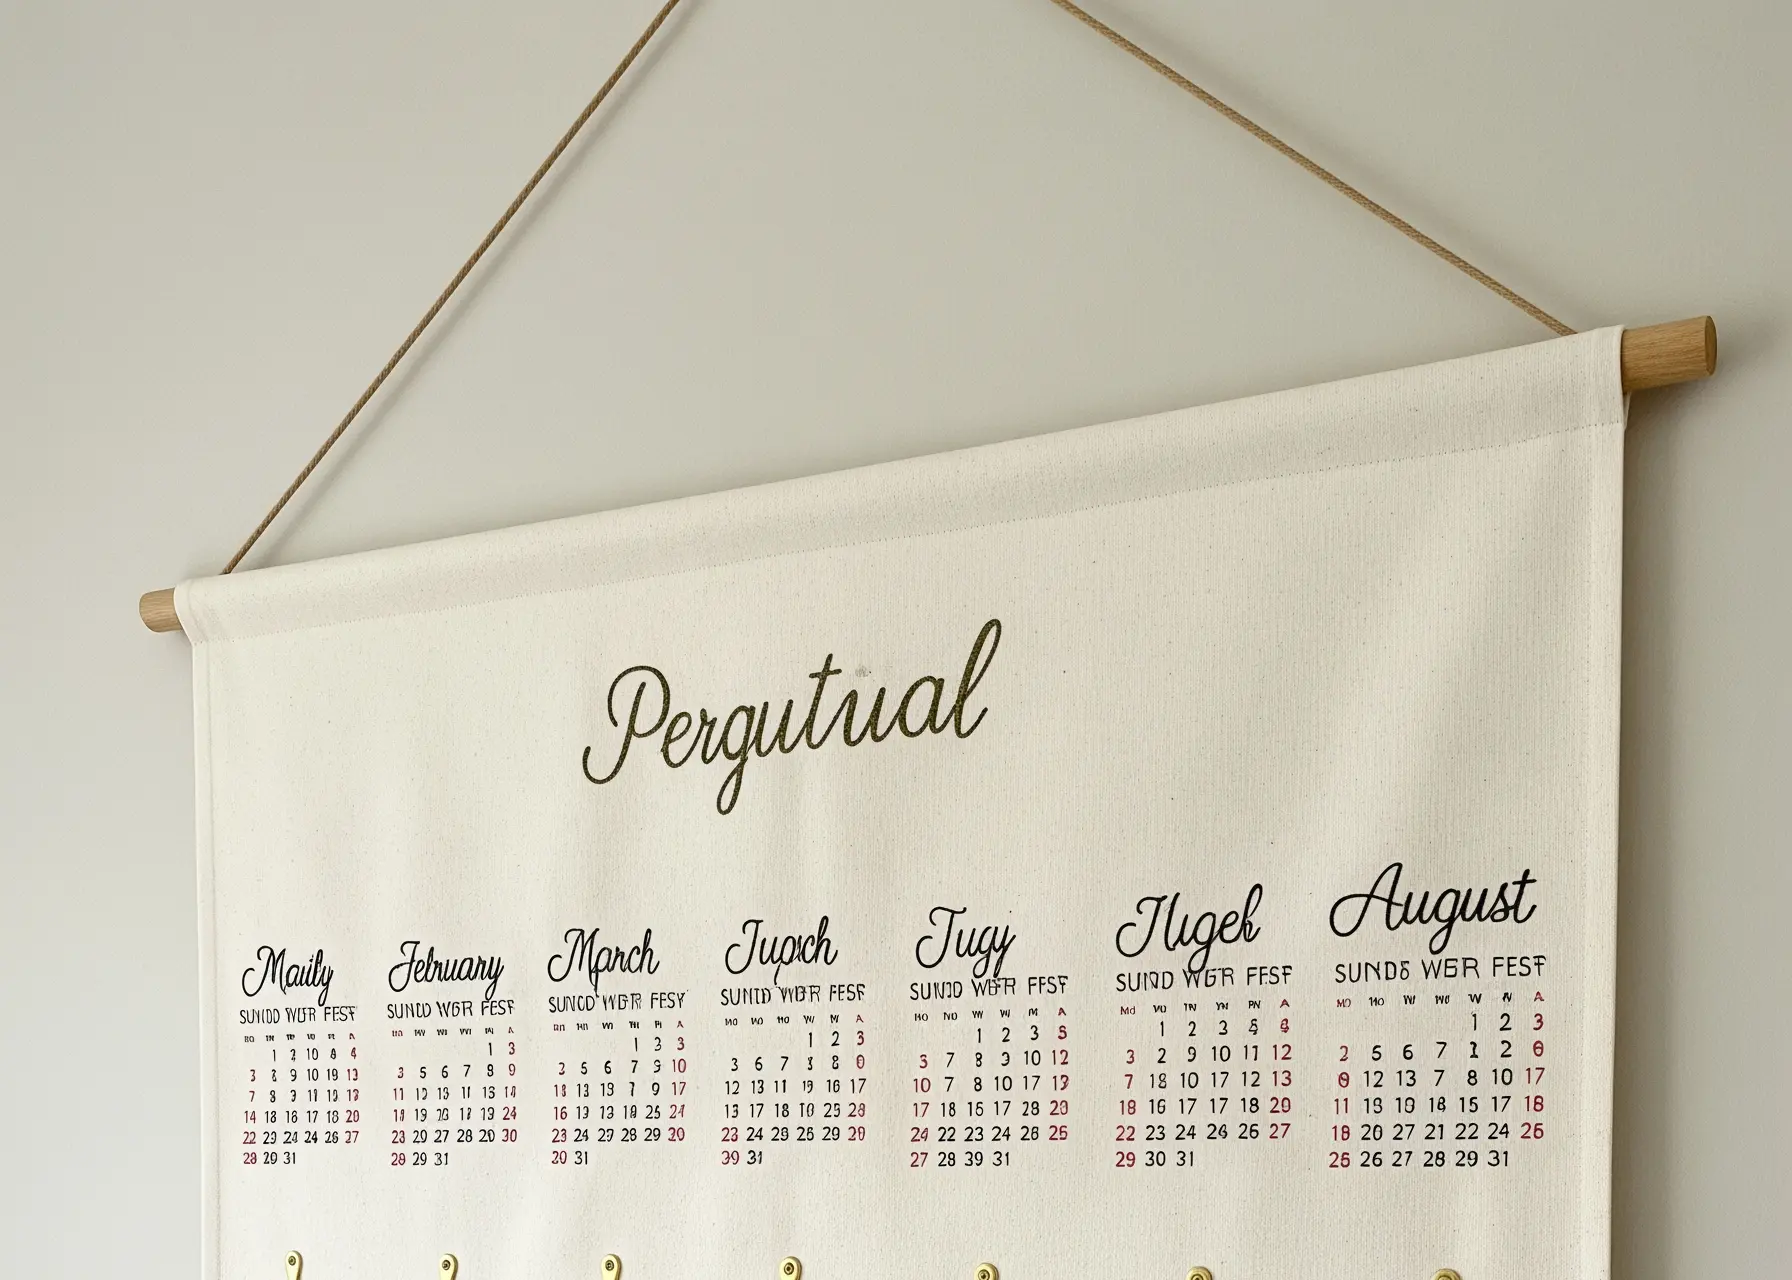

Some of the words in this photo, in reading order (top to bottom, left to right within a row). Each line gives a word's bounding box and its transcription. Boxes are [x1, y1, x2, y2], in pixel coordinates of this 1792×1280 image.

[582, 618, 1002, 816] Pergutual
[1329, 862, 1537, 955] August
[1159, 1020, 1165, 1038] 1
[1187, 1020, 1197, 1037] 2
[1218, 1019, 1229, 1036] 3
[1471, 1012, 1477, 1032] 1
[1498, 1012, 1513, 1032] 2
[1532, 1012, 1545, 1032] 3
[808, 1031, 813, 1049] 1
[830, 1030, 841, 1047] 2
[976, 1027, 982, 1044] 1
[1001, 1026, 1011, 1043] 2
[1030, 1024, 1040, 1041] 3
[488, 1041, 493, 1057] 1
[508, 1041, 516, 1056] 3
[634, 1036, 638, 1053] 1
[676, 1036, 685, 1051] 3
[1371, 1044, 1383, 1062] 5
[1402, 1043, 1414, 1061] 6
[1435, 1041, 1448, 1059] 7
[1500, 1039, 1513, 1059] 2
[272, 1048, 277, 1063] 1
[306, 1047, 319, 1061] 10
[946, 1051, 956, 1069] 7
[1023, 1049, 1042, 1067] 10
[1051, 1048, 1069, 1066] 12
[1125, 1048, 1135, 1065] 3
[1156, 1047, 1167, 1065] 2
[1211, 1044, 1232, 1063] 10
[1272, 1043, 1293, 1061] 12
[419, 1065, 427, 1080] 5
[441, 1064, 449, 1079] 6
[462, 1063, 472, 1078] 7
[508, 1062, 517, 1077] 9
[580, 1061, 588, 1076] 5
[603, 1059, 612, 1075] 6
[630, 1059, 639, 1074] 7
[671, 1057, 687, 1074] 10
[730, 1057, 739, 1072] 3
[754, 1055, 764, 1072] 6
[780, 1055, 789, 1072] 7
[289, 1068, 298, 1083] 9
[306, 1067, 320, 1082] 10
[913, 1077, 932, 1094] 10
[944, 1076, 955, 1093] 7
[973, 1076, 983, 1093] 8
[994, 1075, 1013, 1092] 10
[1022, 1074, 1041, 1091] 17
[1123, 1073, 1134, 1090] 7
[1180, 1071, 1200, 1090] 10
[1210, 1070, 1230, 1089] 17
[1241, 1070, 1261, 1088] 12
[1272, 1069, 1293, 1087] 13
[1363, 1070, 1384, 1089] 12
[1396, 1069, 1417, 1088] 13
[1433, 1069, 1446, 1087] 7
[1466, 1069, 1479, 1087] 8
[1491, 1067, 1514, 1087] 10
[1525, 1066, 1546, 1086] 17
[651, 1081, 661, 1097] 9
[671, 1081, 687, 1096] 17
[724, 1080, 740, 1096] 12
[849, 1077, 867, 1095] 17
[248, 1090, 256, 1103] 7
[1333, 1097, 1349, 1115] 11
[1491, 1095, 1512, 1113] 17
[553, 1105, 568, 1121] 16
[749, 1102, 765, 1119] 17
[774, 1102, 790, 1118] 18
[912, 1101, 930, 1118] 17
[940, 1101, 957, 1118] 18
[993, 1100, 1012, 1117] 17
[1021, 1100, 1040, 1117] 28
[1119, 1098, 1137, 1116] 18
[1178, 1097, 1198, 1116] 17
[1209, 1096, 1229, 1115] 17
[1240, 1096, 1260, 1114] 18
[244, 1110, 257, 1125] 14
[306, 1109, 319, 1124] 17
[345, 1109, 360, 1124] 20
[303, 1130, 319, 1144] 24
[344, 1130, 360, 1145] 27
[433, 1128, 450, 1144] 27
[456, 1128, 474, 1143] 28
[620, 1127, 638, 1143] 28
[643, 1127, 662, 1142] 29
[745, 1126, 764, 1142] 24
[937, 1126, 957, 1143] 22
[963, 1125, 984, 1143] 23
[991, 1125, 1012, 1142] 24
[1115, 1124, 1136, 1142] 22
[1145, 1124, 1166, 1142] 23
[1174, 1123, 1197, 1141] 24
[1237, 1122, 1260, 1140] 26
[1268, 1122, 1292, 1140] 27
[1392, 1122, 1416, 1141] 27
[1424, 1122, 1444, 1141] 21
[1454, 1122, 1479, 1141] 22
[1487, 1121, 1510, 1141] 24
[283, 1151, 296, 1165] 31
[412, 1151, 428, 1166] 29
[433, 1151, 449, 1167] 31
[573, 1150, 588, 1166] 31
[746, 1149, 763, 1166] 31
[910, 1151, 929, 1168] 27
[937, 1151, 956, 1168] 28
[964, 1150, 984, 1167] 39
[992, 1150, 1010, 1167] 31
[1115, 1150, 1136, 1168] 29
[1144, 1150, 1167, 1167] 30
[1176, 1150, 1194, 1167] 31
[1359, 1150, 1383, 1168] 26
[1391, 1150, 1414, 1168] 27
[1422, 1150, 1446, 1168] 28
[1454, 1149, 1479, 1168] 29
[1487, 1149, 1509, 1168] 31
